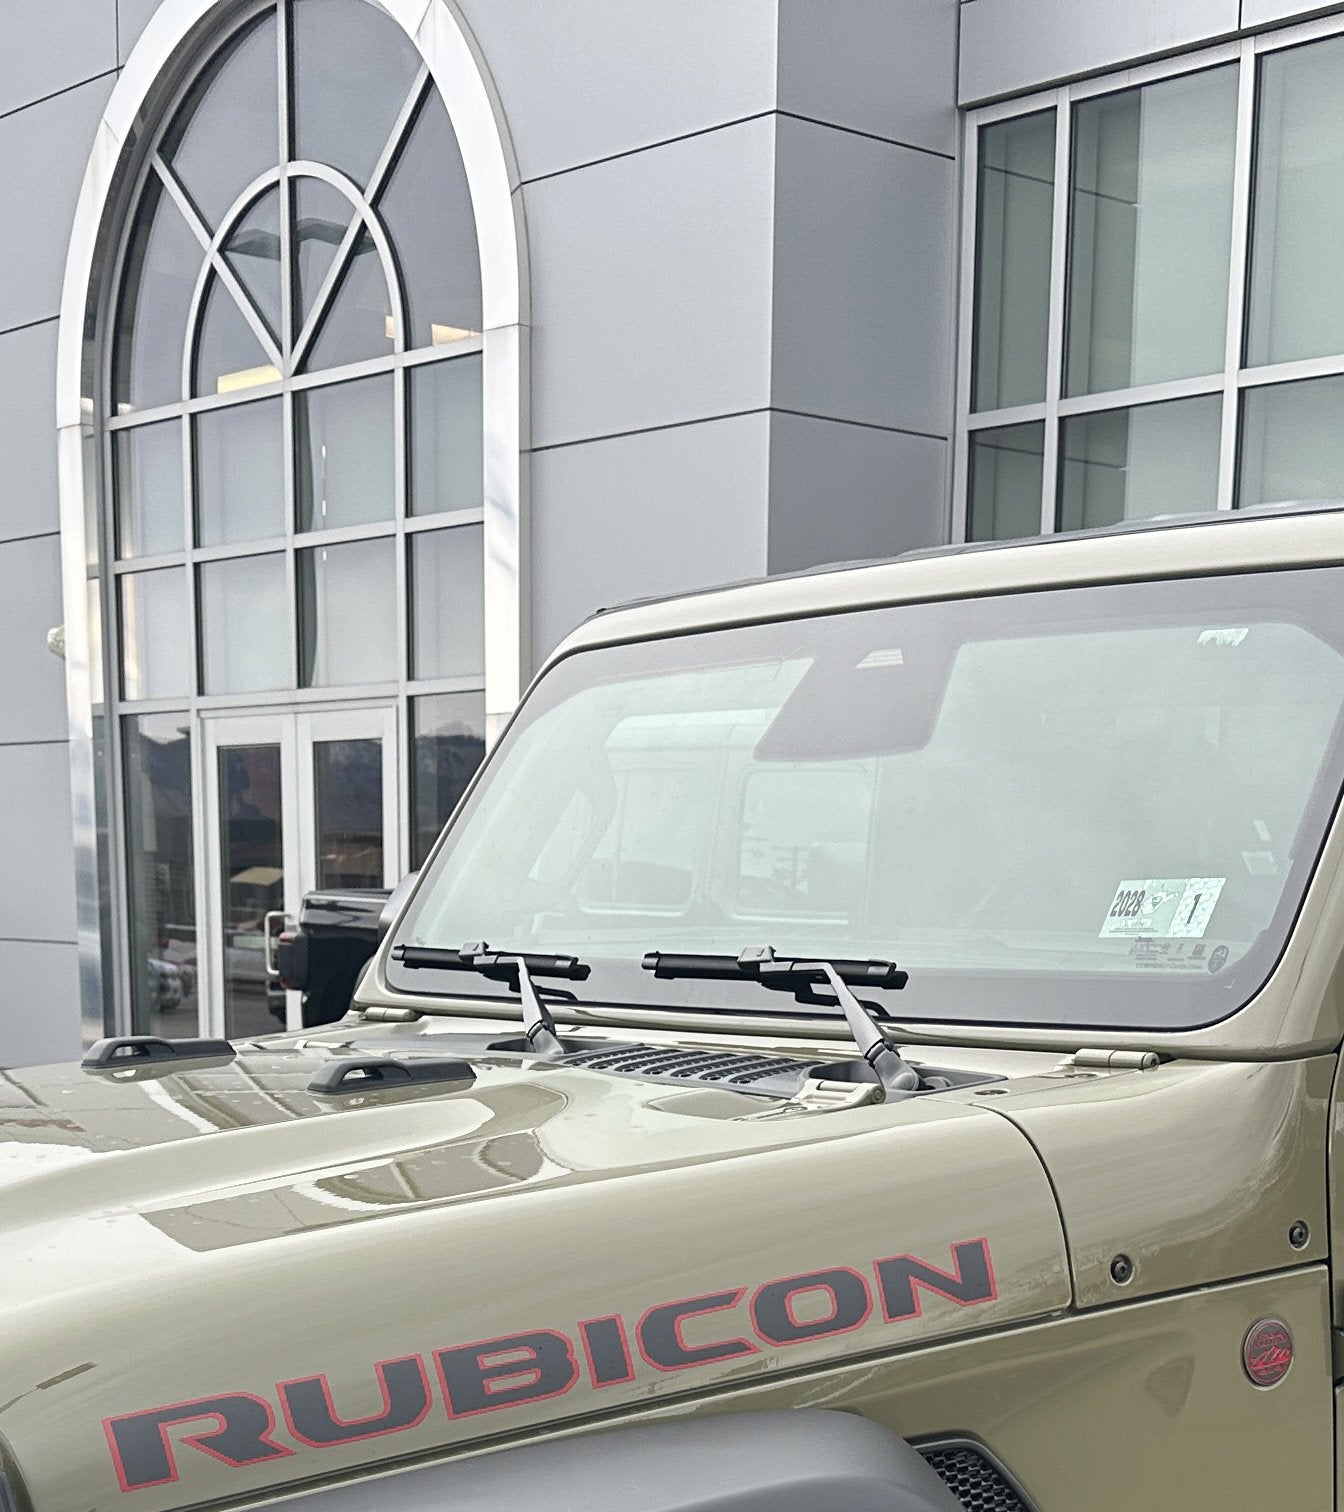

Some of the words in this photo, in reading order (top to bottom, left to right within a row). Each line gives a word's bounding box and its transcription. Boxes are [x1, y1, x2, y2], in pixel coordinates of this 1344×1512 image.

[1109, 889, 1146, 917] 2028
[1186, 893, 1202, 926] 1
[103, 1236, 999, 1493] RUBICON
